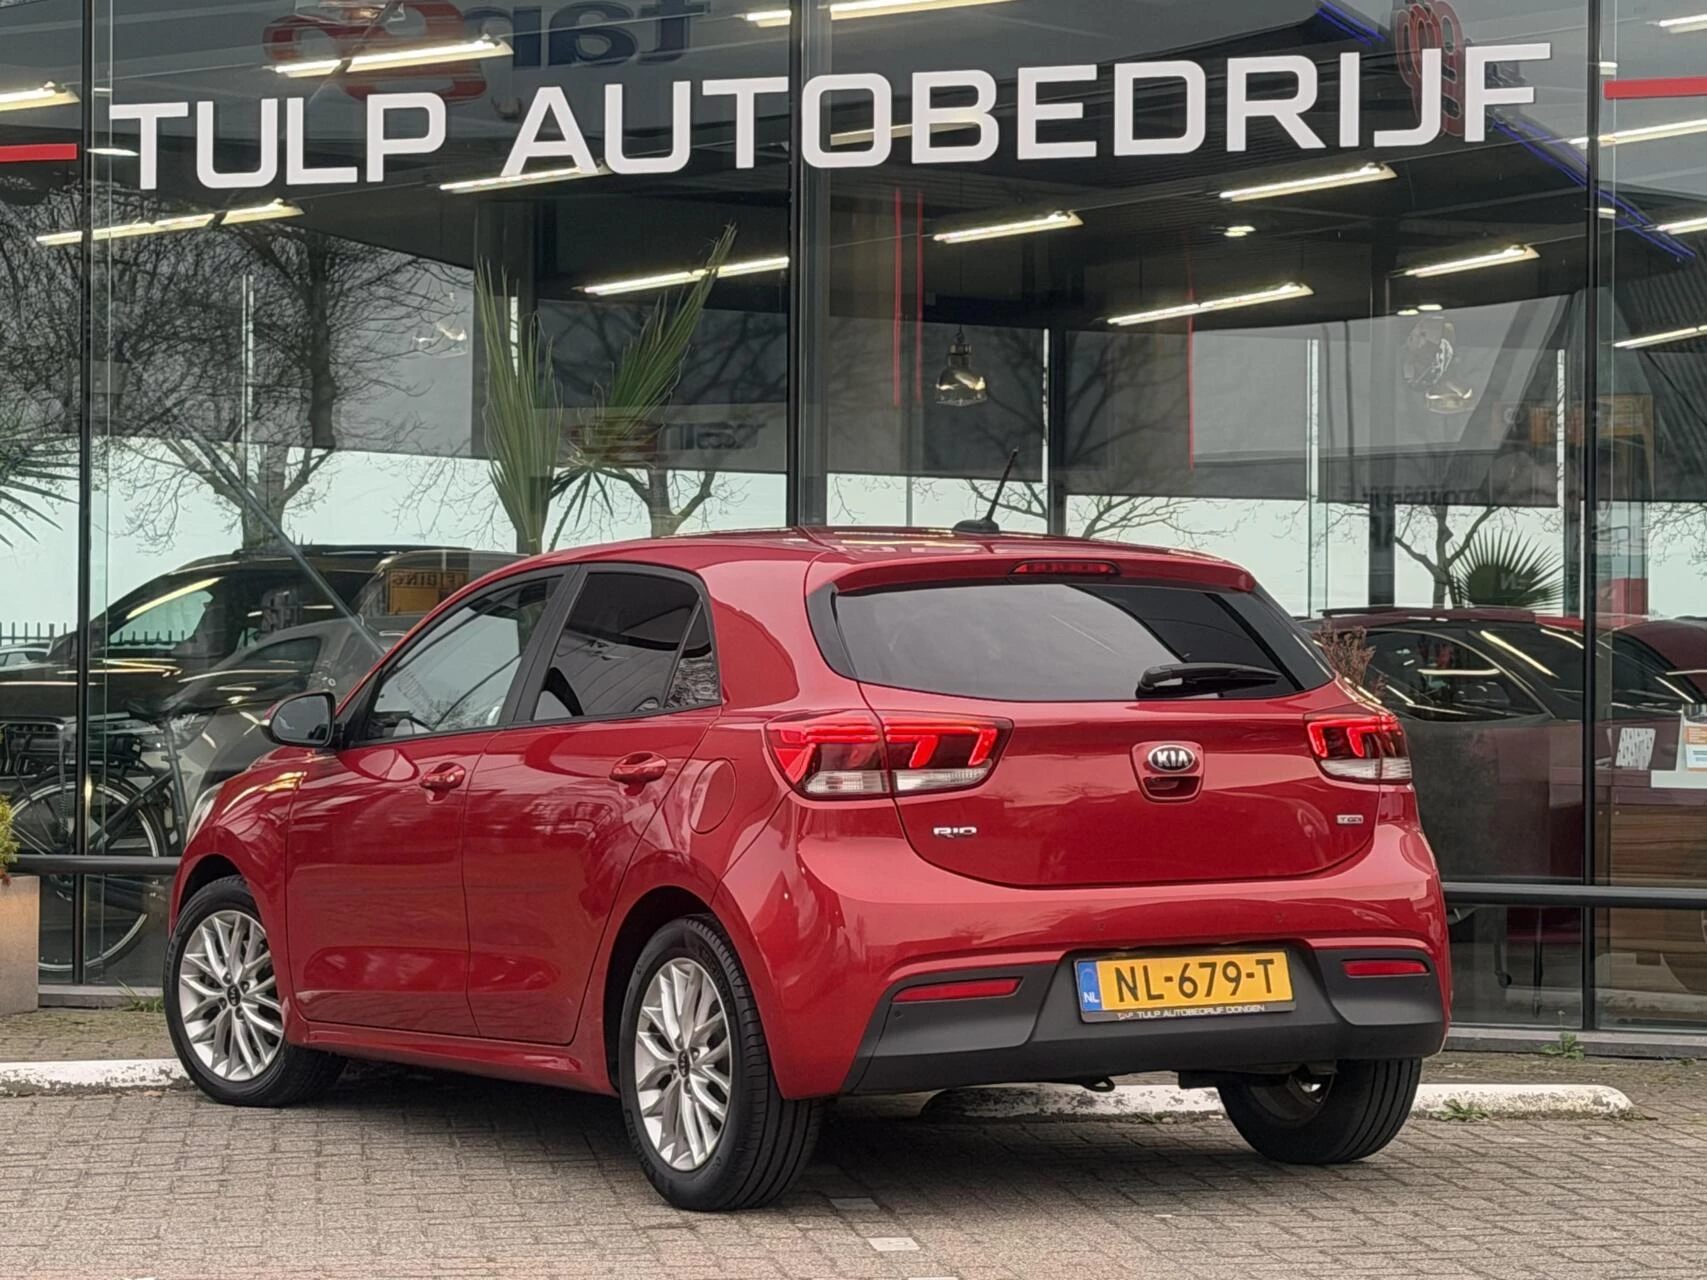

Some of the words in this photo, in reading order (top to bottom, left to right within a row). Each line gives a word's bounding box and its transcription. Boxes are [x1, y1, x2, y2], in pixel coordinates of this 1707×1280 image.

[109, 92, 446, 190] TULP
[500, 43, 1551, 176] AUTOBEDRIJF
[1156, 750, 1190, 768] KIA
[933, 826, 977, 838] RIO
[1114, 958, 1275, 1003] NL-679-T
[1082, 991, 1100, 1003] NL
[1137, 1010, 1161, 1019] TULP
[1162, 1006, 1225, 1018] AUTOBEDRIJF
[1225, 1004, 1265, 1013] DONGEN
